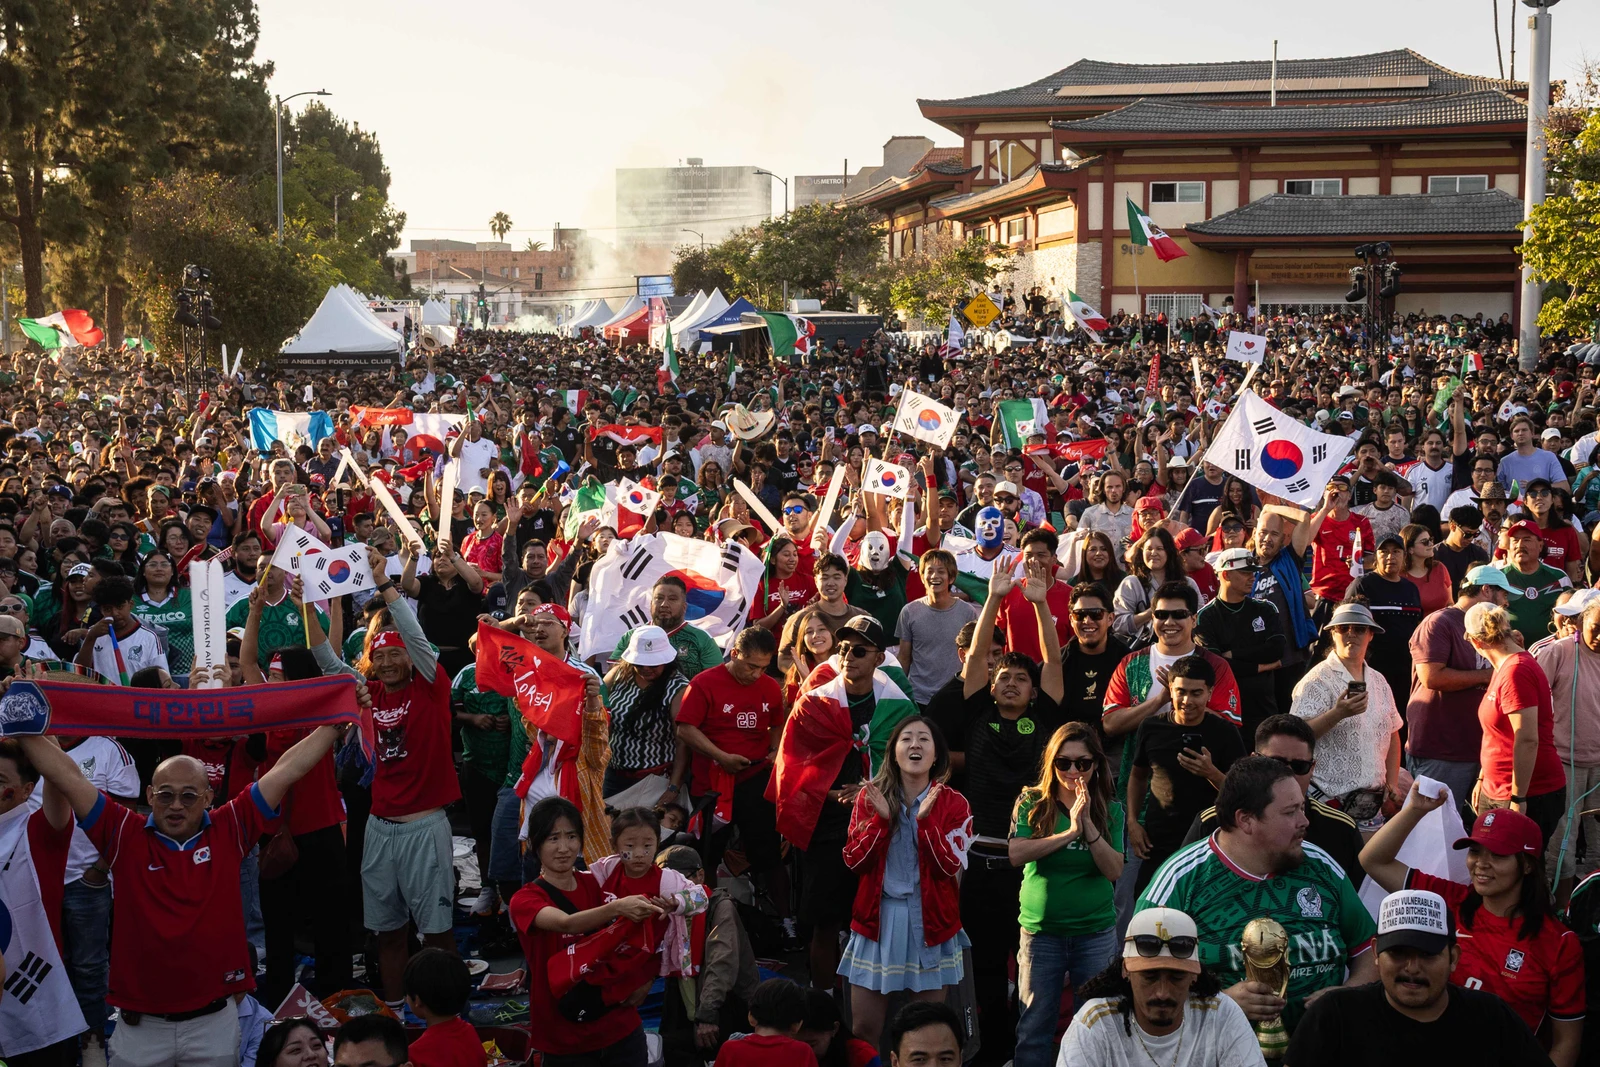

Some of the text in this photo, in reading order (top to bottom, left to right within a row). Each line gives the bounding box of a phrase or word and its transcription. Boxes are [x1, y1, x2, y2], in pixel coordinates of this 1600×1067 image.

[692, 169, 711, 178] Hope
[1421, 483, 1429, 494] 9
[1336, 545, 1344, 558] 7
[135, 611, 187, 623] MEXICO
[203, 605, 211, 648] KOREAN
[133, 698, 255, 725] 대한민국
[762, 702, 770, 712] K
[737, 711, 757, 729] 26
[1389, 898, 1401, 907] VERY
[1401, 896, 1433, 908] VULNERABLE
[1433, 900, 1441, 910] RN
[1386, 908, 1395, 917] ANY
[1395, 907, 1405, 916] BAD
[1405, 906, 1428, 916] BITCHES
[1428, 908, 1441, 919] WANT
[1382, 915, 1443, 930] TO TAKE ADVANTAGE OF ME
[1315, 963, 1336, 974] TOUR
[1501, 971, 1517, 980] KOREA
